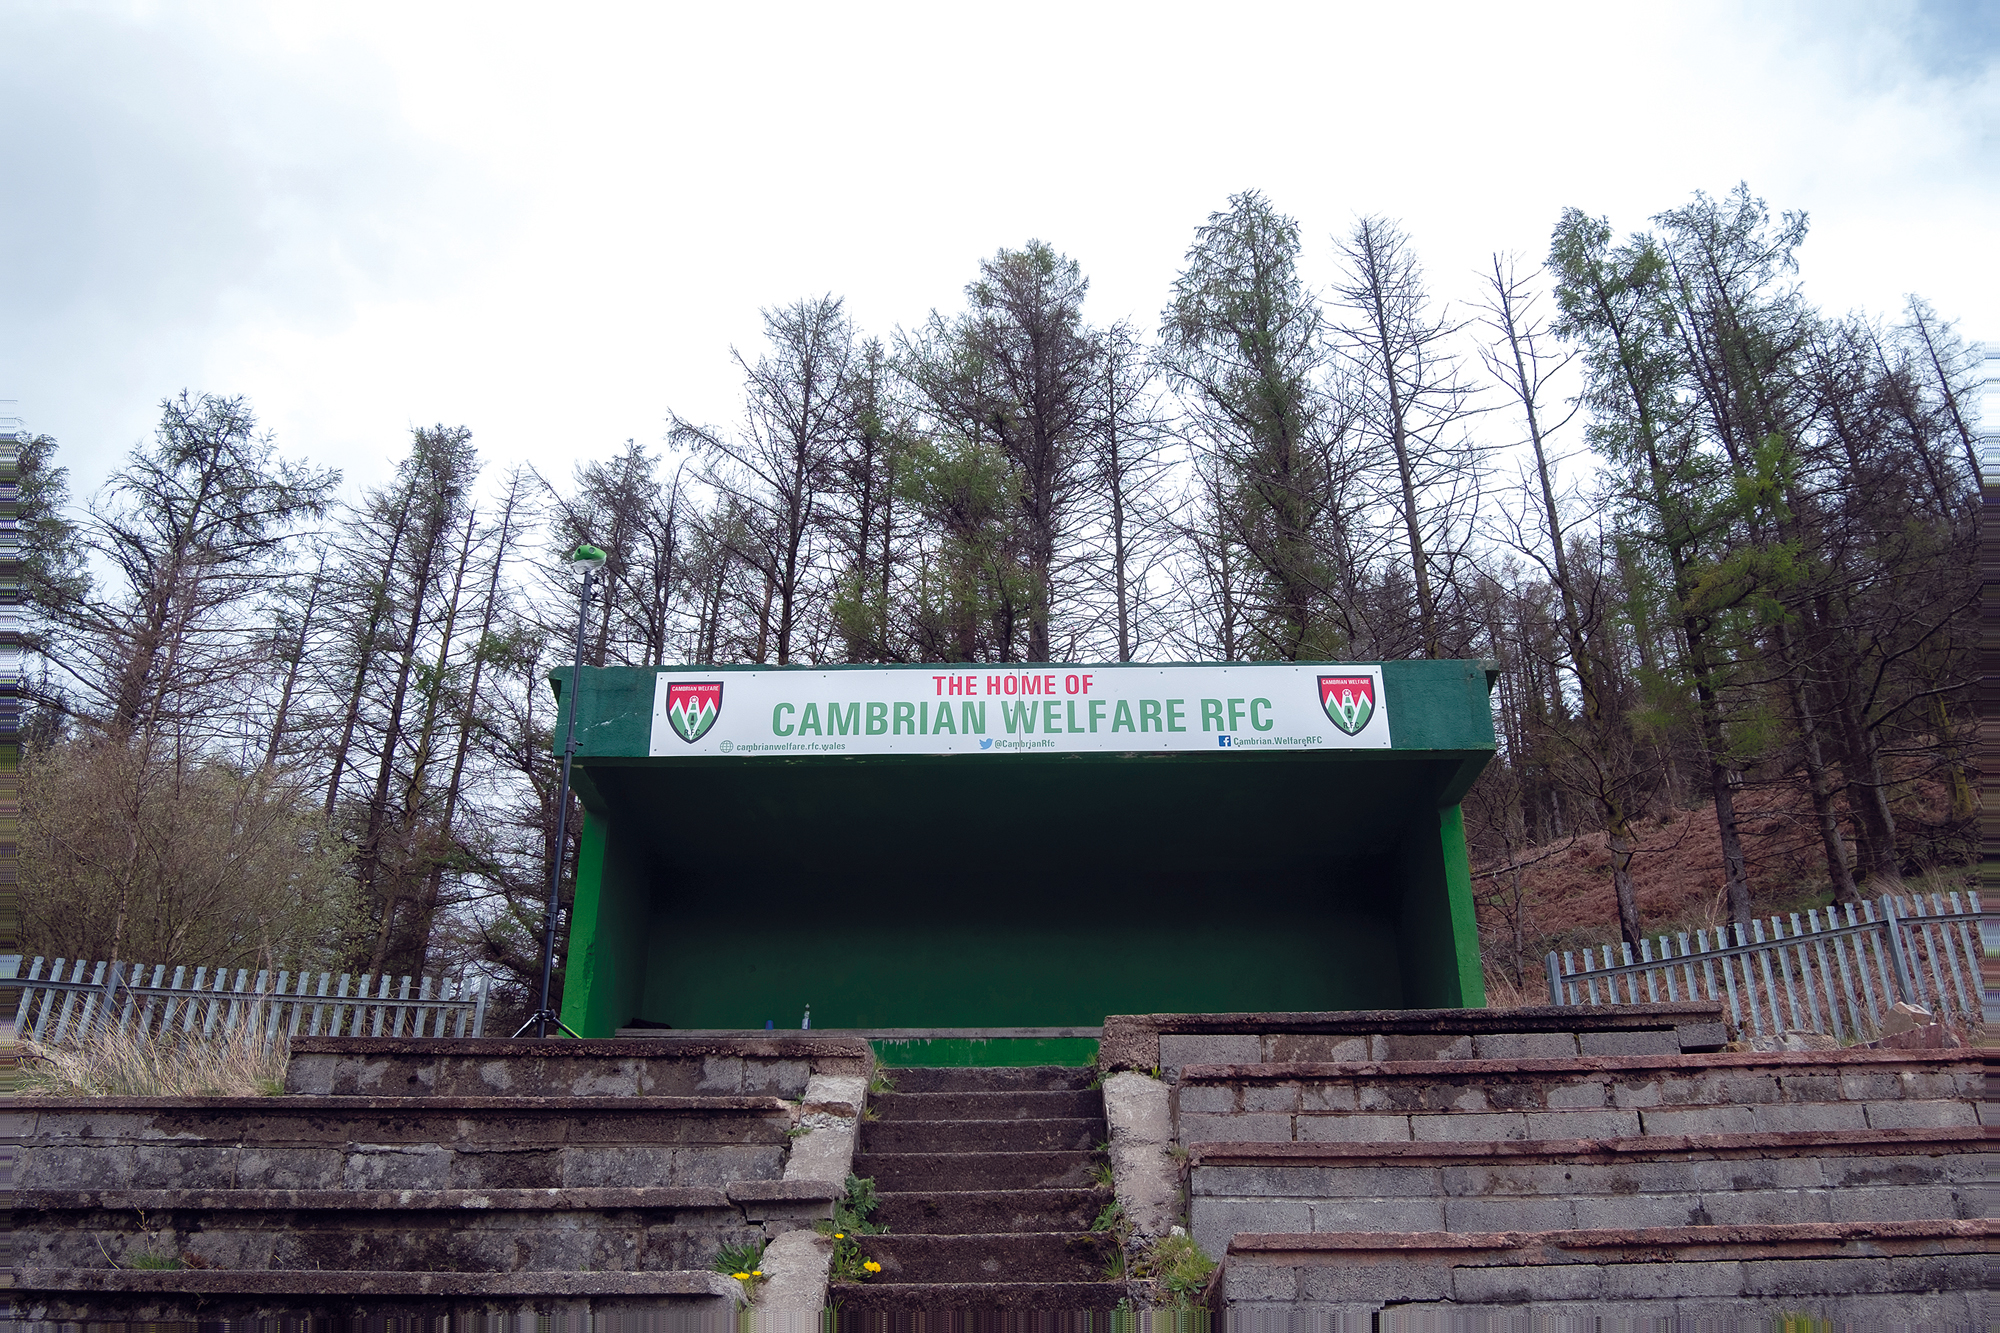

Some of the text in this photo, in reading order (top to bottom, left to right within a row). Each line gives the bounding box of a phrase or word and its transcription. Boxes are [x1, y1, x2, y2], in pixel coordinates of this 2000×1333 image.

[933, 674, 1093, 695] THE HOME OF
[773, 697, 1275, 736] CAMBRIAN WELFARE RFC
[736, 741, 846, 751] cambrianwelfare.rfc.wales
[994, 739, 1055, 748] @CambrianRfc
[1233, 736, 1323, 746] Cambrian.WelfareRFC
